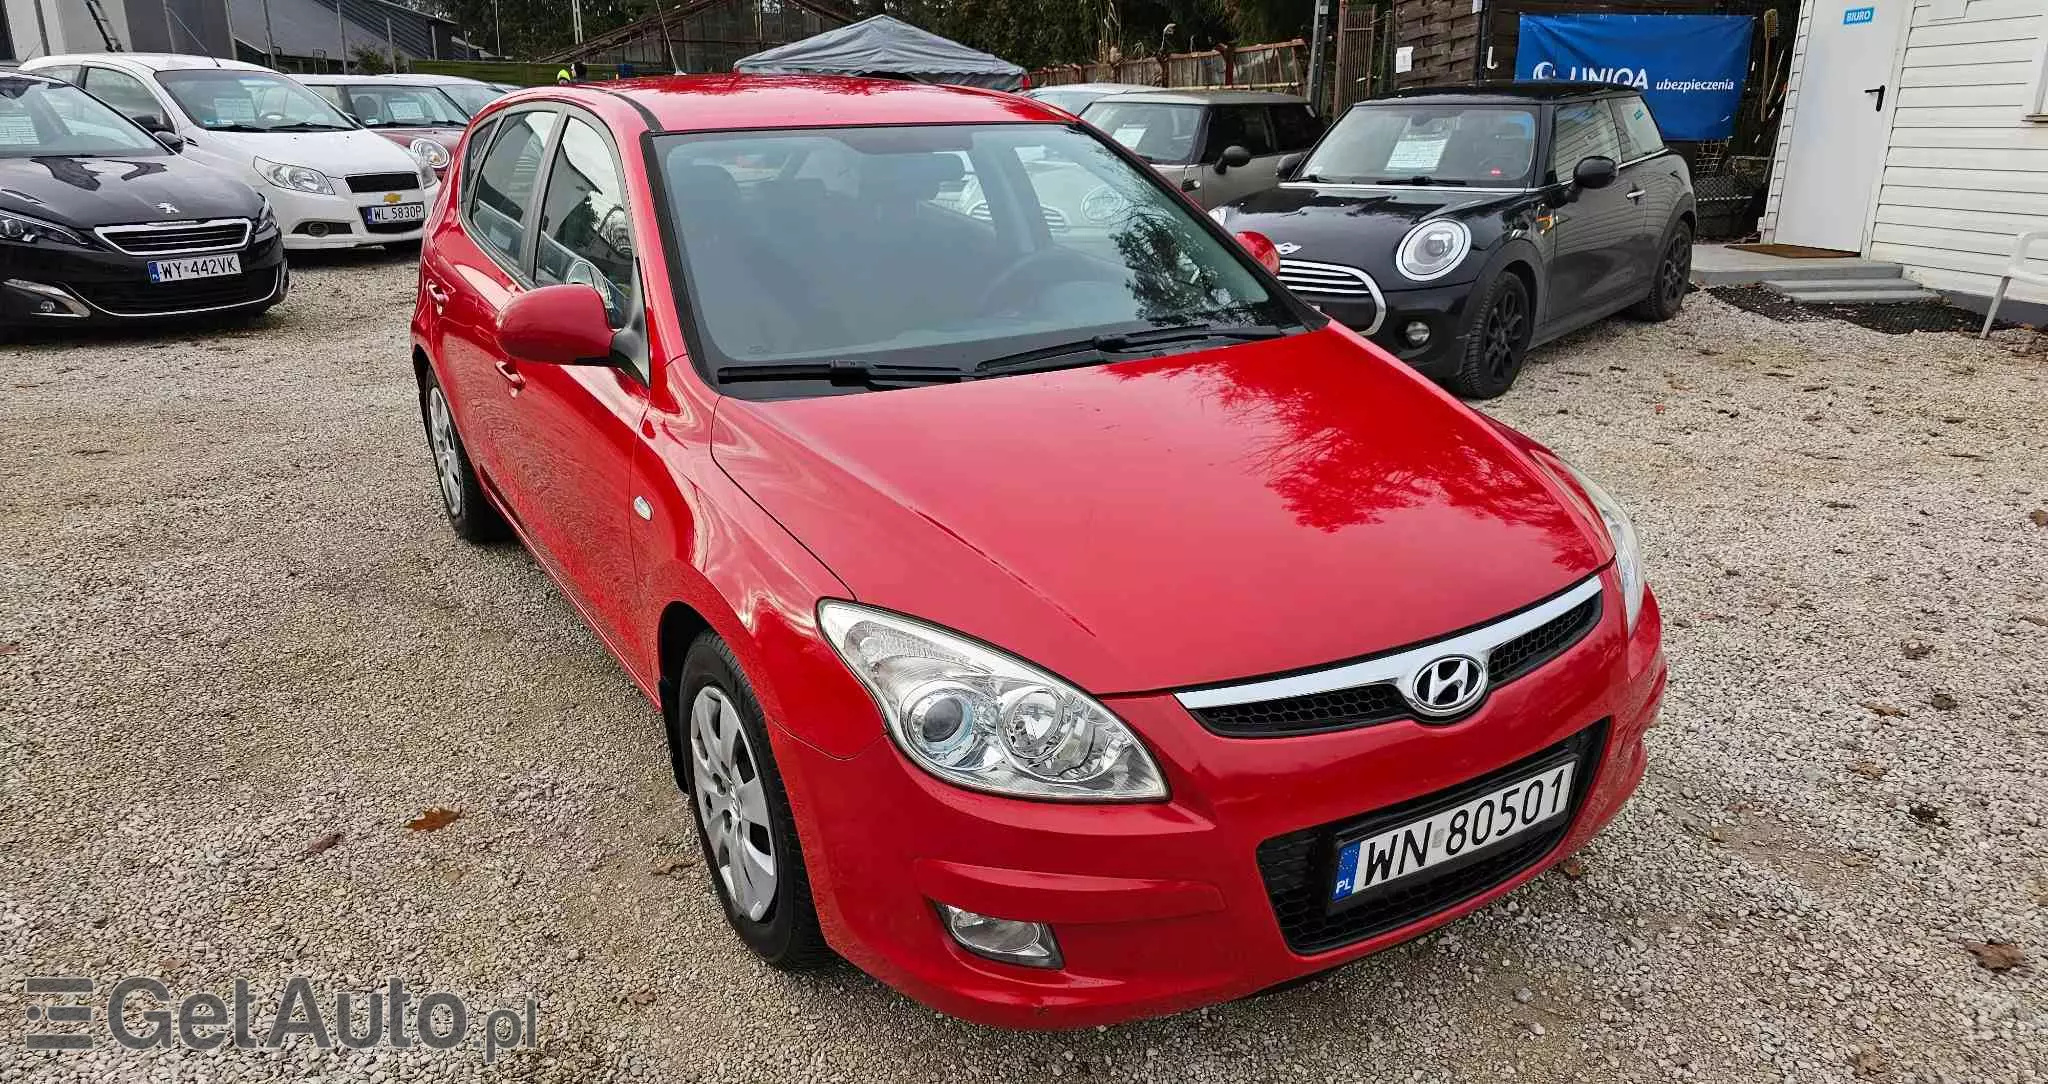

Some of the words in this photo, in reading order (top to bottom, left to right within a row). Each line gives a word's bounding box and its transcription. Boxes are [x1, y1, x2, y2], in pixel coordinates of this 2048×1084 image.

[1846, 10, 1871, 22] BIURO
[1656, 78, 1734, 93] ubezpieczenia
[374, 208, 389, 220] WL
[161, 262, 182, 279] WY
[190, 256, 237, 275] 442VK
[1364, 821, 1433, 887] WN
[1446, 768, 1565, 856] 80501
[1335, 879, 1351, 894] PL
